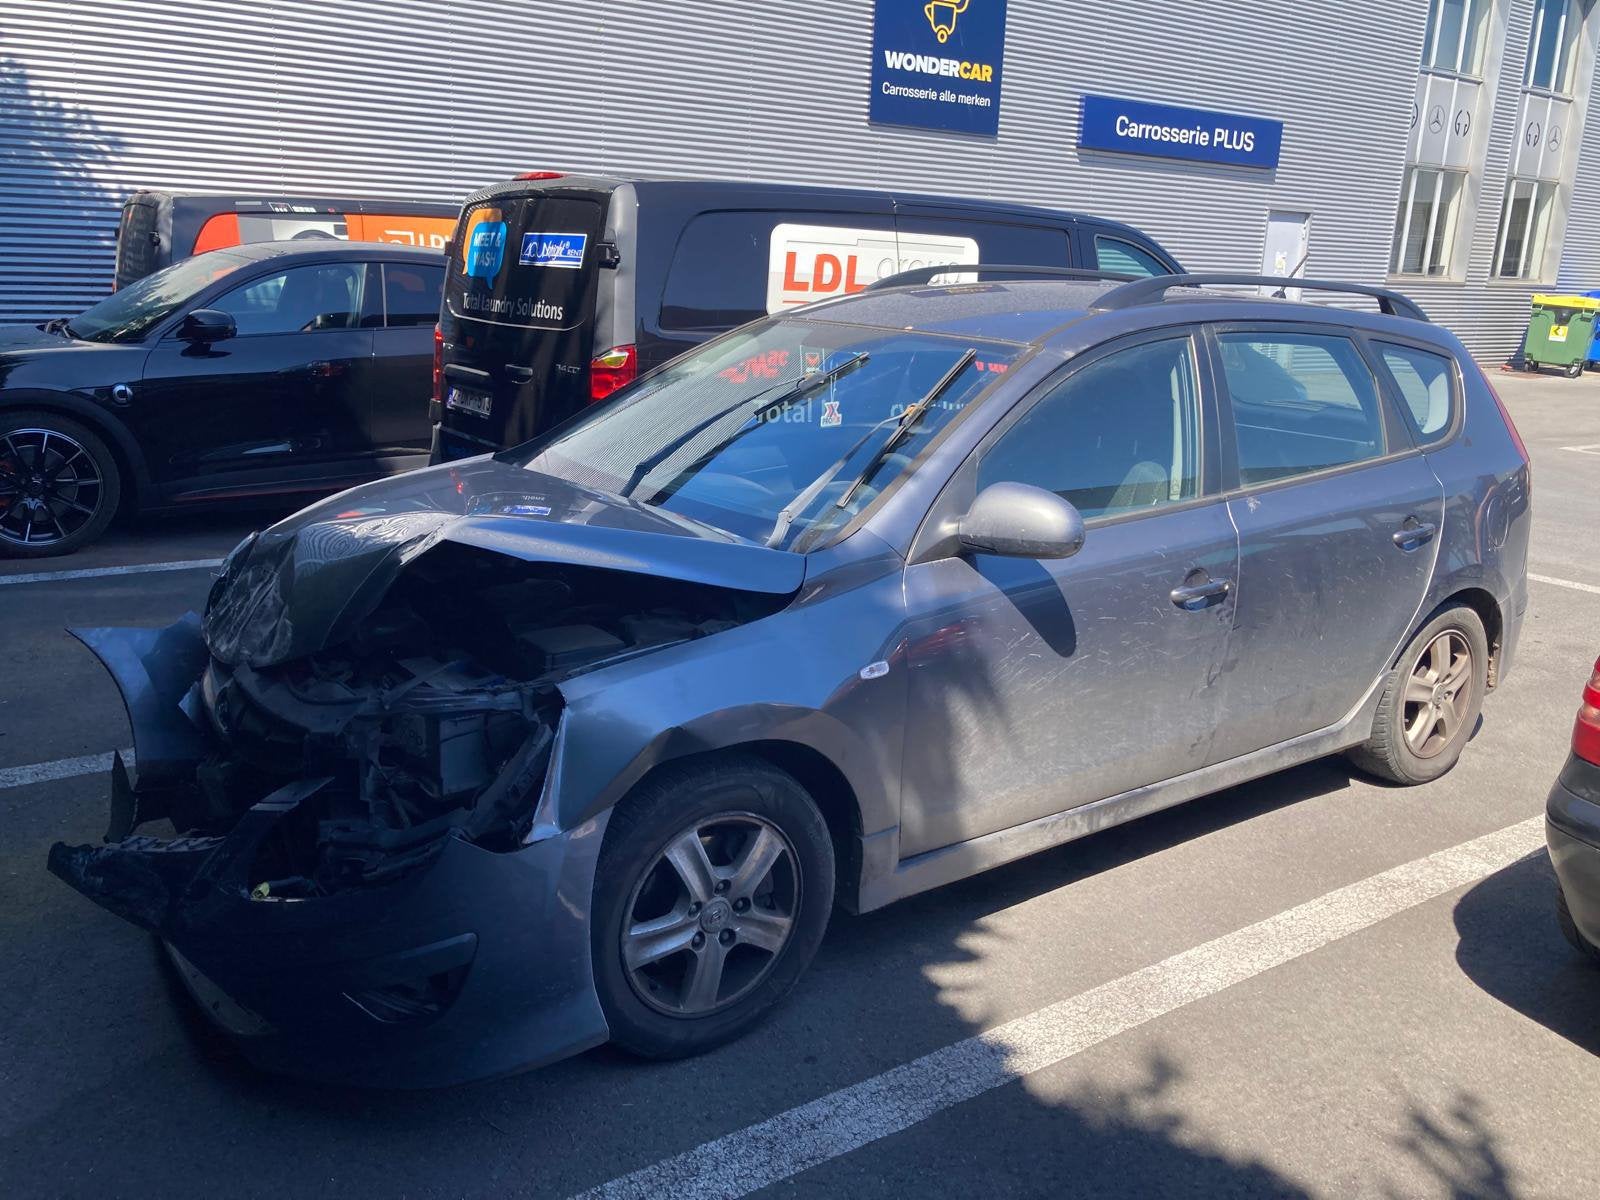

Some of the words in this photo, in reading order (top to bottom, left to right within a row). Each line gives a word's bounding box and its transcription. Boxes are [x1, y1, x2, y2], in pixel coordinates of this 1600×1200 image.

[884, 50, 993, 82] WONDERCAR
[882, 81, 938, 101] Carrosserie
[939, 90, 956, 103] alle
[958, 94, 991, 107] merken
[1115, 115, 1210, 146] Carrosserie
[1213, 127, 1255, 152] PLUS
[473, 232, 496, 247] MEET
[473, 251, 497, 267] WASH
[782, 251, 870, 294] LDL
[463, 292, 480, 310] Total
[481, 294, 516, 318] Laundry
[516, 297, 563, 321] Solutions
